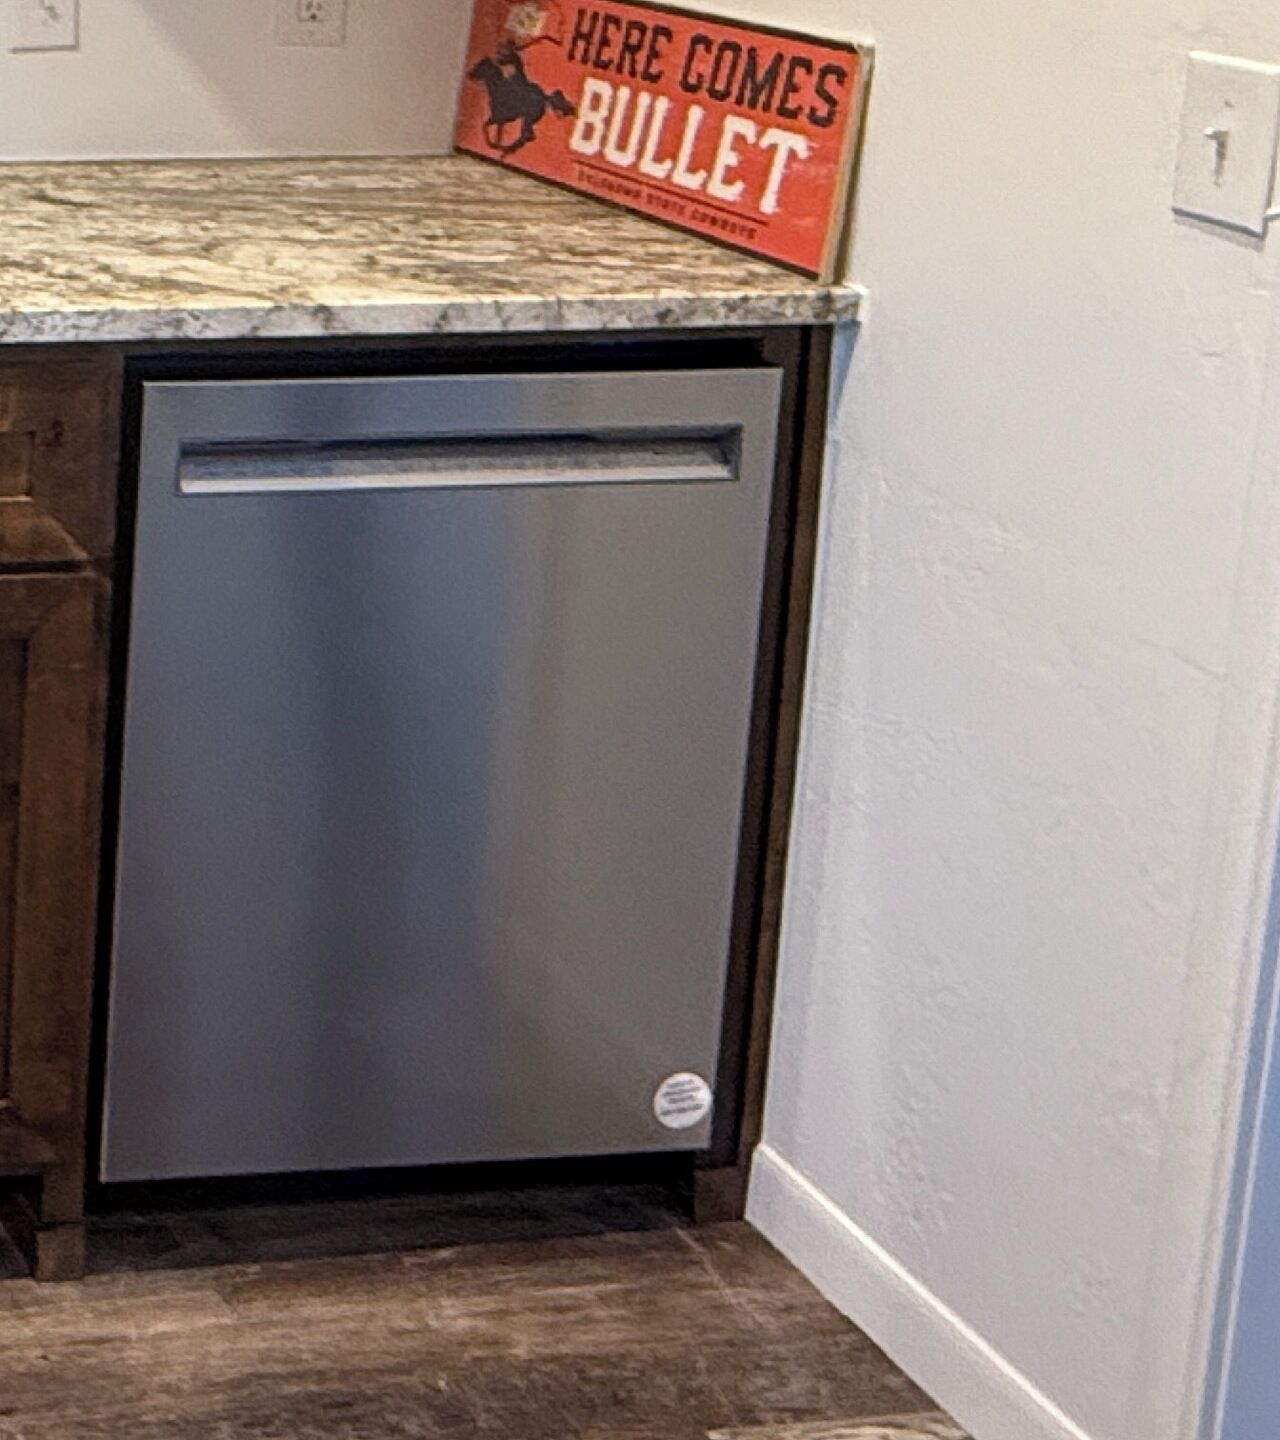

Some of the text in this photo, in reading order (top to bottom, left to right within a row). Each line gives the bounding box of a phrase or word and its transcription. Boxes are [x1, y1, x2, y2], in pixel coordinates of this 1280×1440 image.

[566, 8, 848, 128] HERE COMES
[568, 77, 816, 216] BULLET
